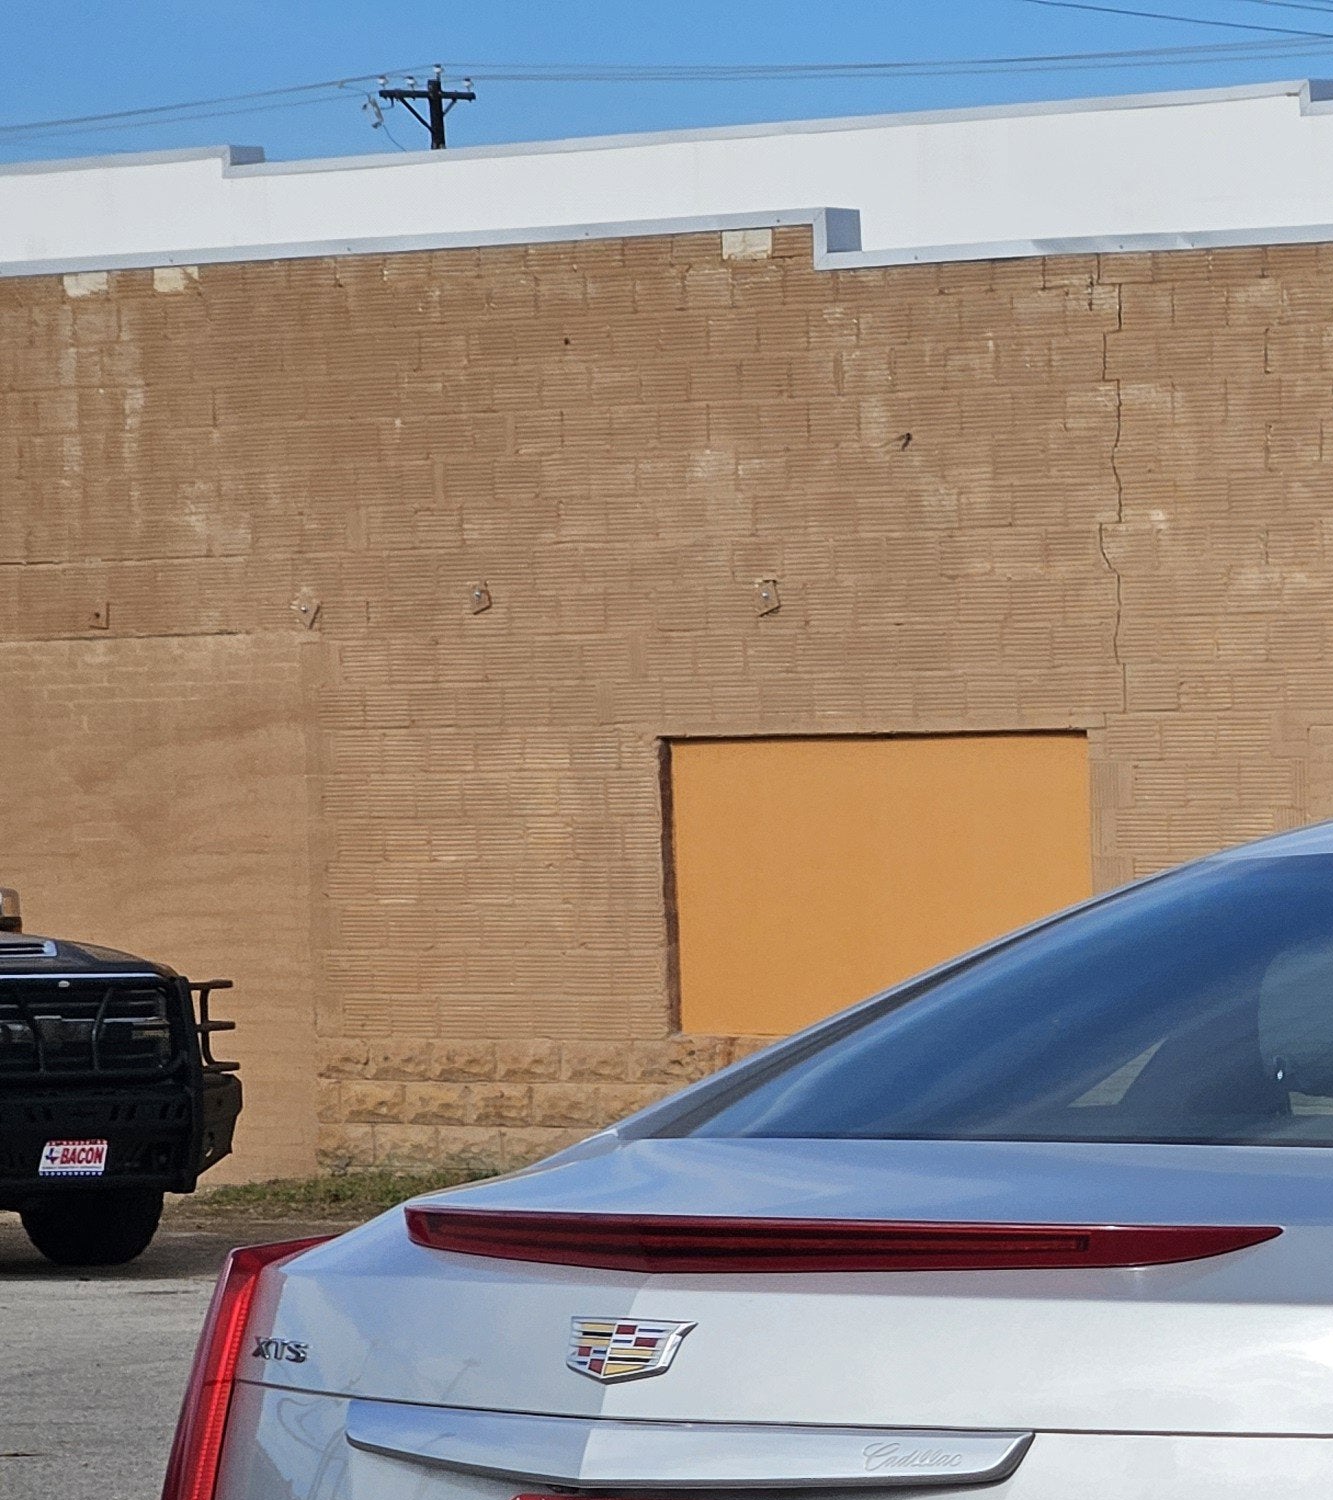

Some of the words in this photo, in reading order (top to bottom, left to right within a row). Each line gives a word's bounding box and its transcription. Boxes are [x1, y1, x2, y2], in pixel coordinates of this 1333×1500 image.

[60, 1147, 105, 1165] BACON
[251, 1335, 308, 1363] XTS
[862, 1442, 963, 1472] Cadillac
